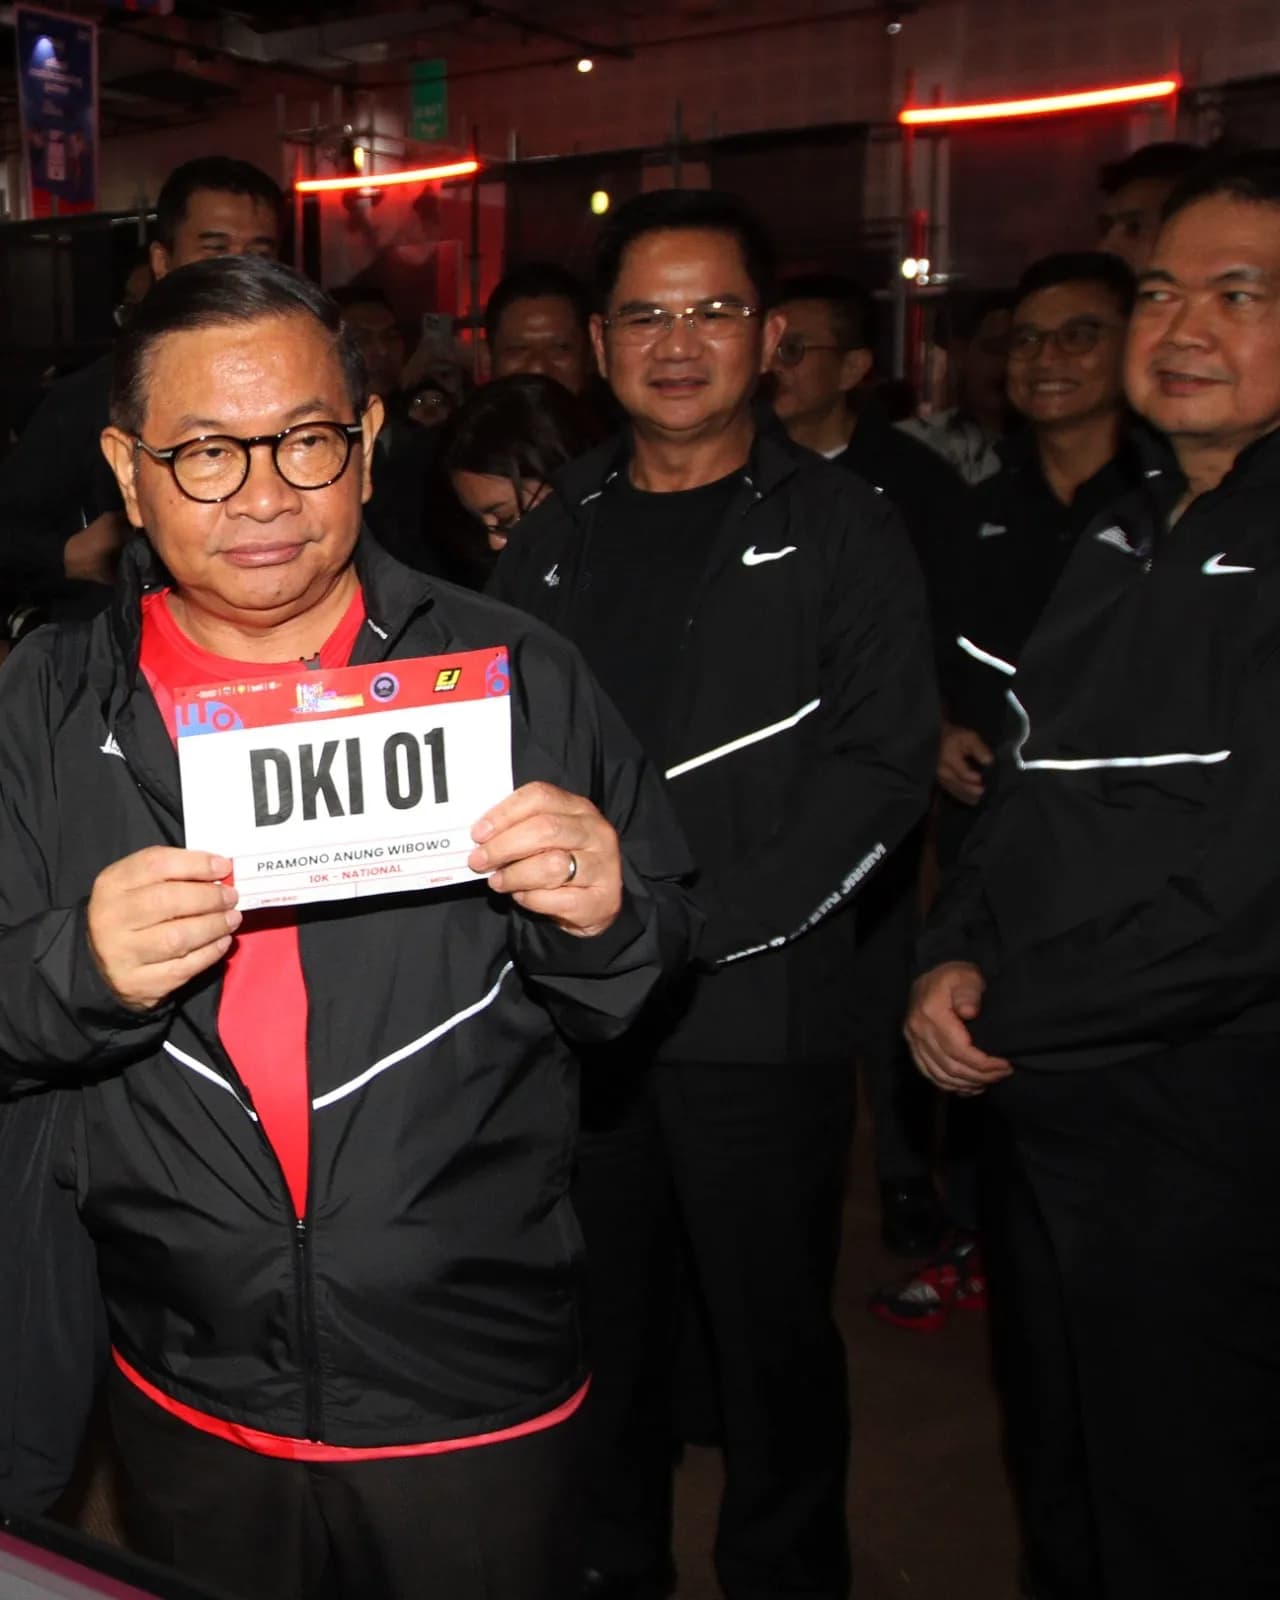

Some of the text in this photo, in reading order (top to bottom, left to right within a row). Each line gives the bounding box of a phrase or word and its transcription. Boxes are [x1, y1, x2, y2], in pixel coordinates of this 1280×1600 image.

[250, 727, 449, 827] DKI 01
[257, 838, 451, 872] PRAMONO ANUNG WIBOWO
[309, 874, 329, 884] 10K
[342, 864, 403, 881] NATIONAL
